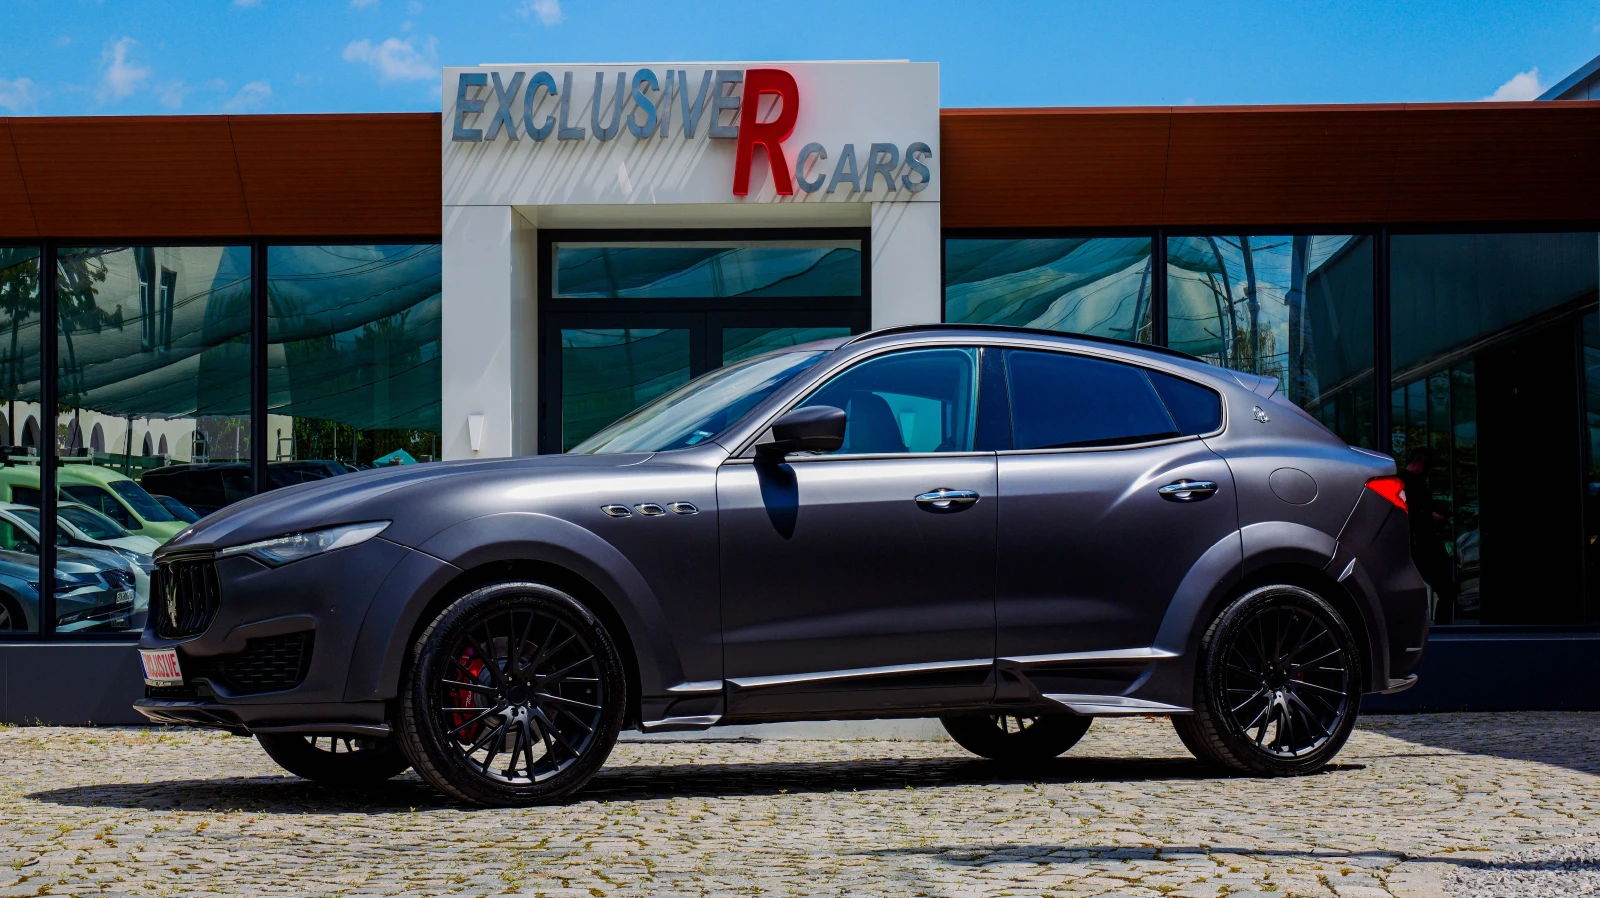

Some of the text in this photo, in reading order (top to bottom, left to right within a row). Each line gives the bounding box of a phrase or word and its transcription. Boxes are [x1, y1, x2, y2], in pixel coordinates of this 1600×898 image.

[451, 68, 800, 195] EXCLUSIVE R
[795, 141, 933, 194] CARS
[142, 653, 181, 677] CLUSIVE
